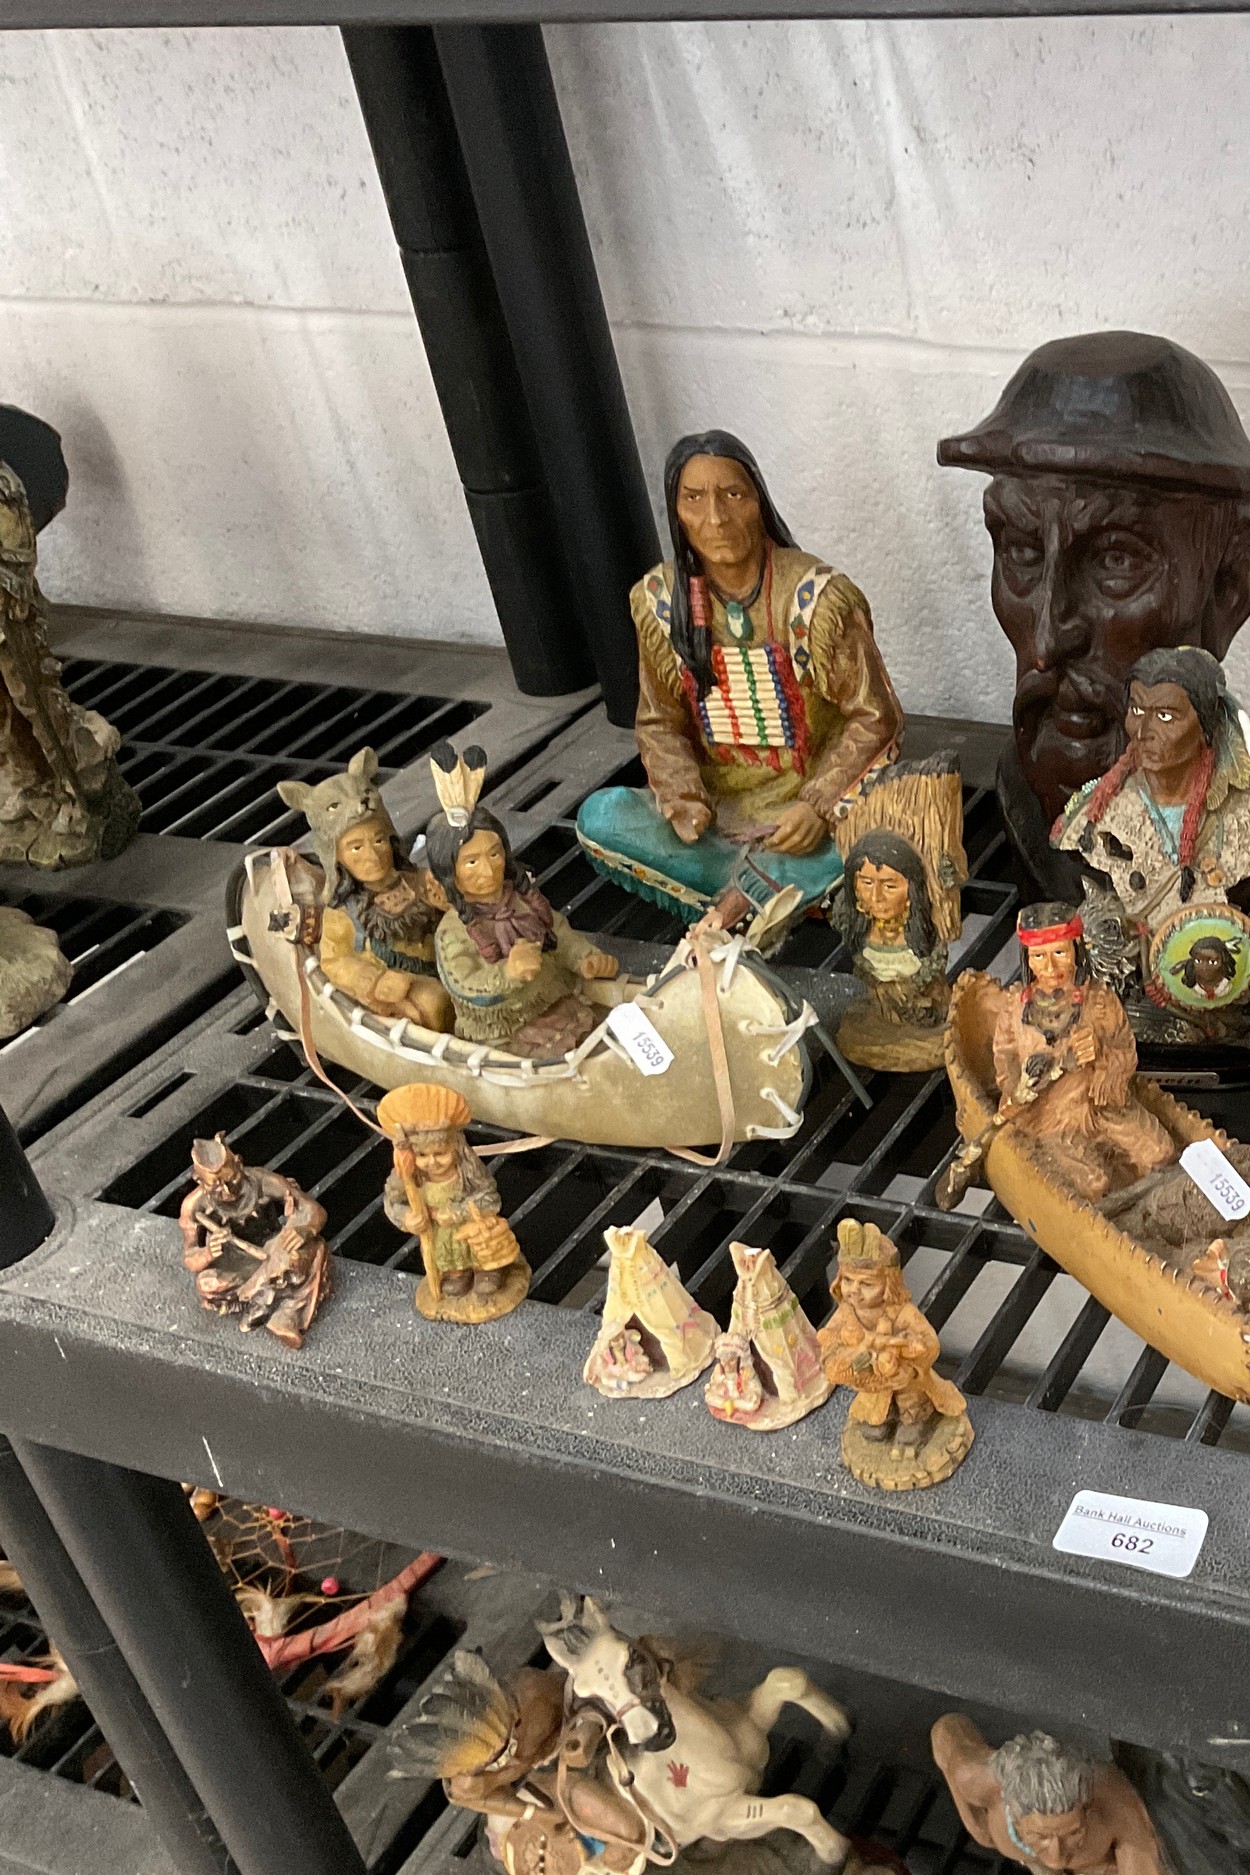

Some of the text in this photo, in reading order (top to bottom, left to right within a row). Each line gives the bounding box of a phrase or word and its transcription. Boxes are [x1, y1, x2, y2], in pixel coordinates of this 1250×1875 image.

[632, 1031, 665, 1067] 15539
[1209, 1173, 1246, 1212] 15539
[1073, 1504, 1188, 1537] Bank Hall Auctions
[1111, 1532, 1155, 1555] 682
